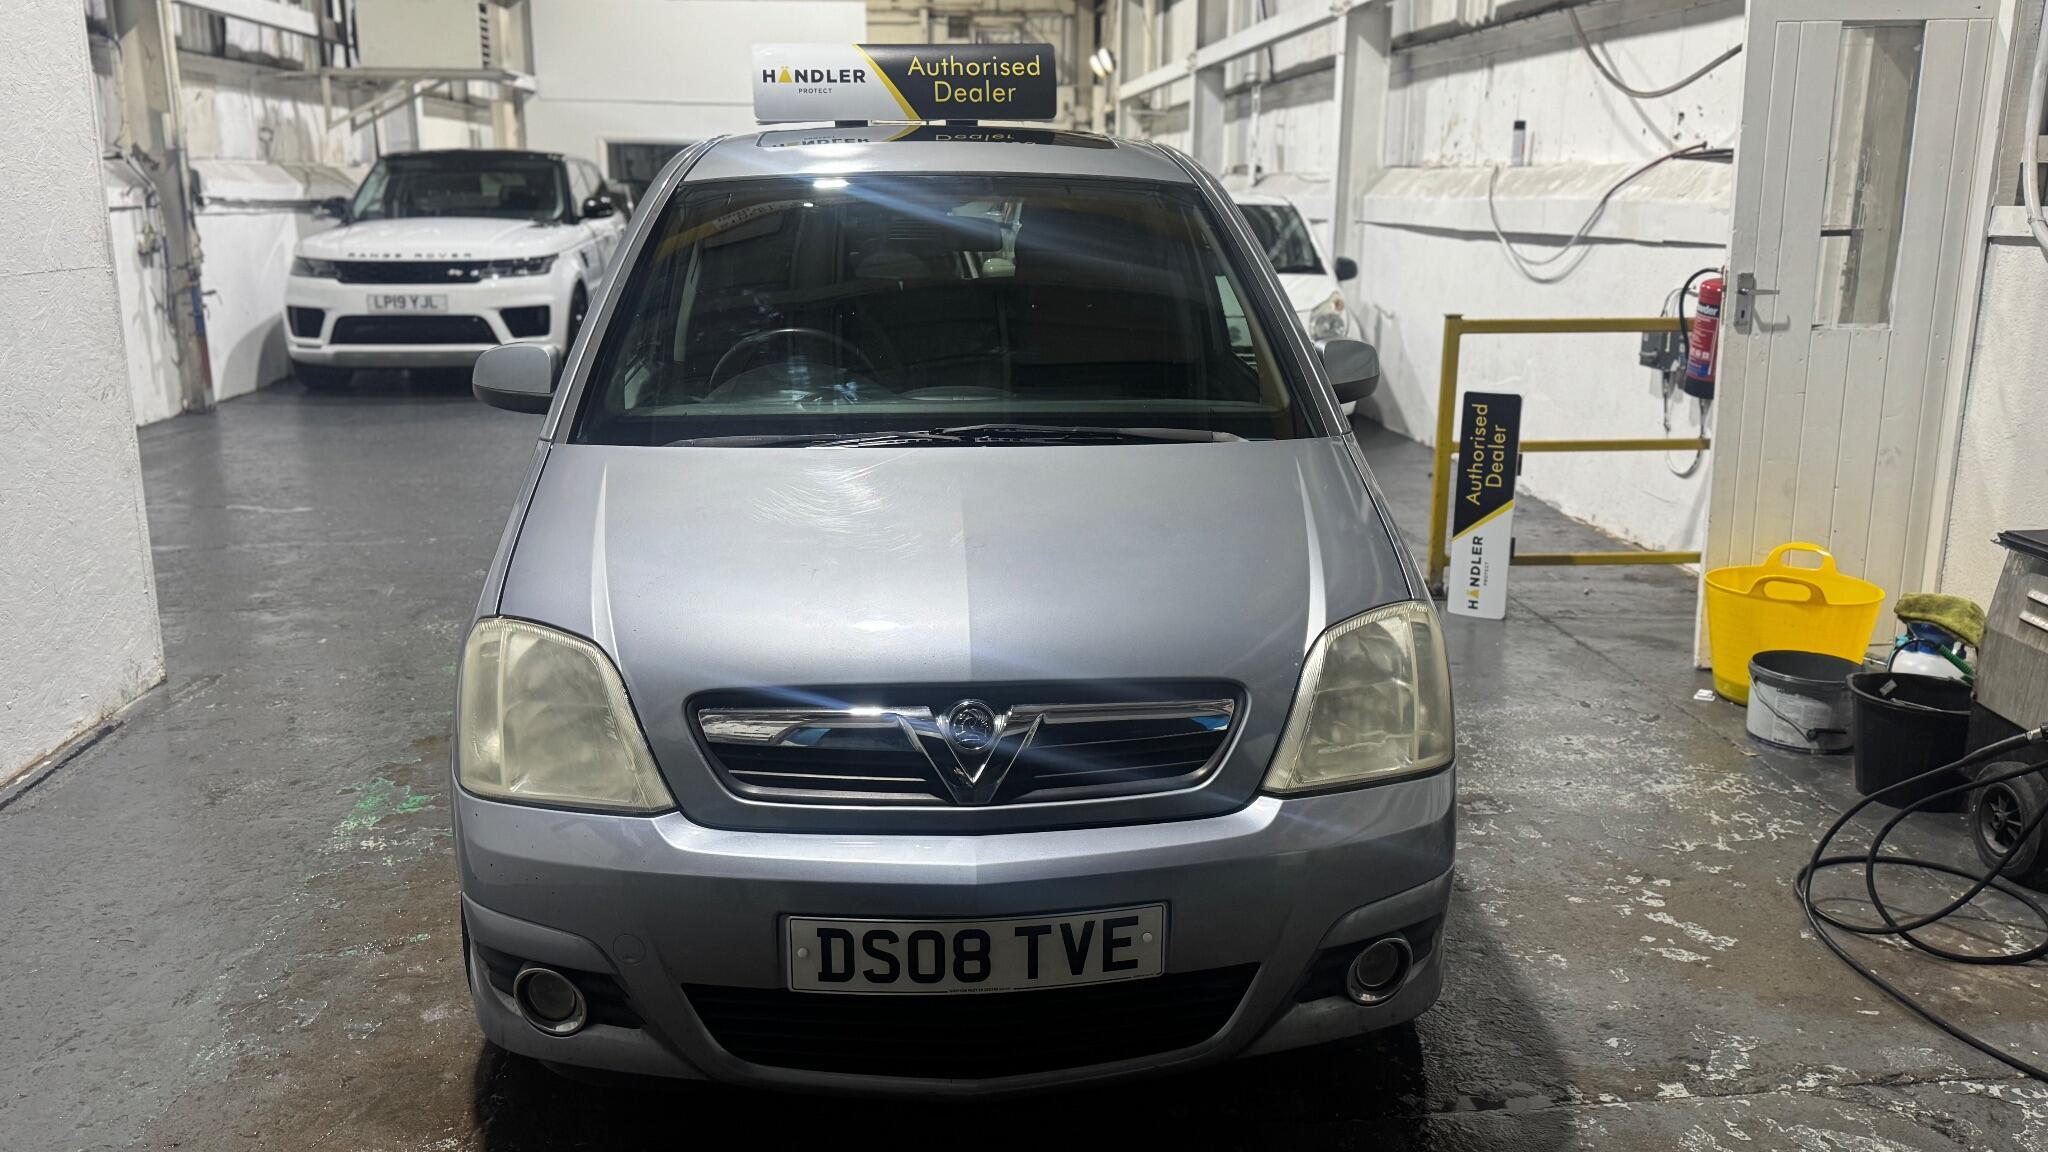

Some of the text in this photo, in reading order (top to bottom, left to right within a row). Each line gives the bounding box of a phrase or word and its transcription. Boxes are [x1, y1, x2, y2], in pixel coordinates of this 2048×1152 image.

[908, 54, 1041, 77] Authorised
[934, 79, 1017, 103] Dealer
[374, 295, 438, 309] LP19 YJL
[1466, 404, 1488, 506] Authorised
[1485, 424, 1507, 488] Dealer
[816, 915, 1139, 984] DS08 TVE
